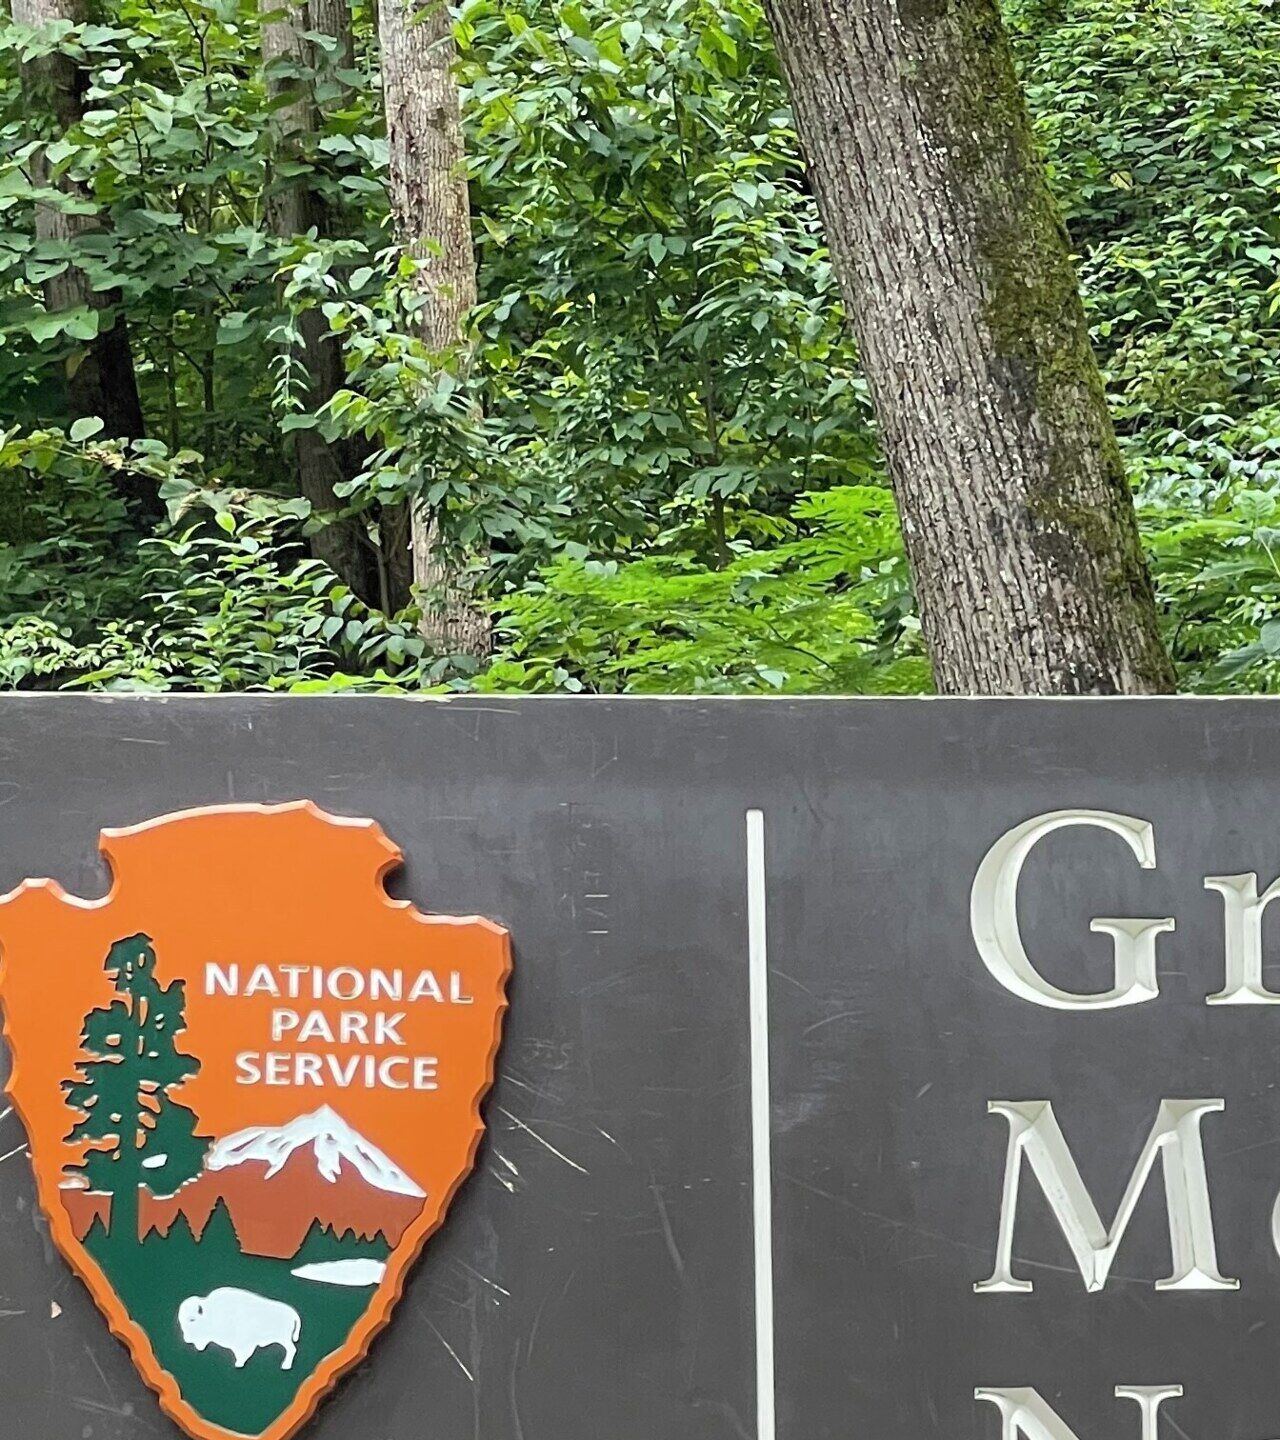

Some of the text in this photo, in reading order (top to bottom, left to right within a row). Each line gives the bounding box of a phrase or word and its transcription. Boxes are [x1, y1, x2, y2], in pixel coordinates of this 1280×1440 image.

[203, 960, 475, 1005] NATIONAL
[270, 1006, 407, 1047] PARK
[233, 1049, 440, 1091] SERVICE
